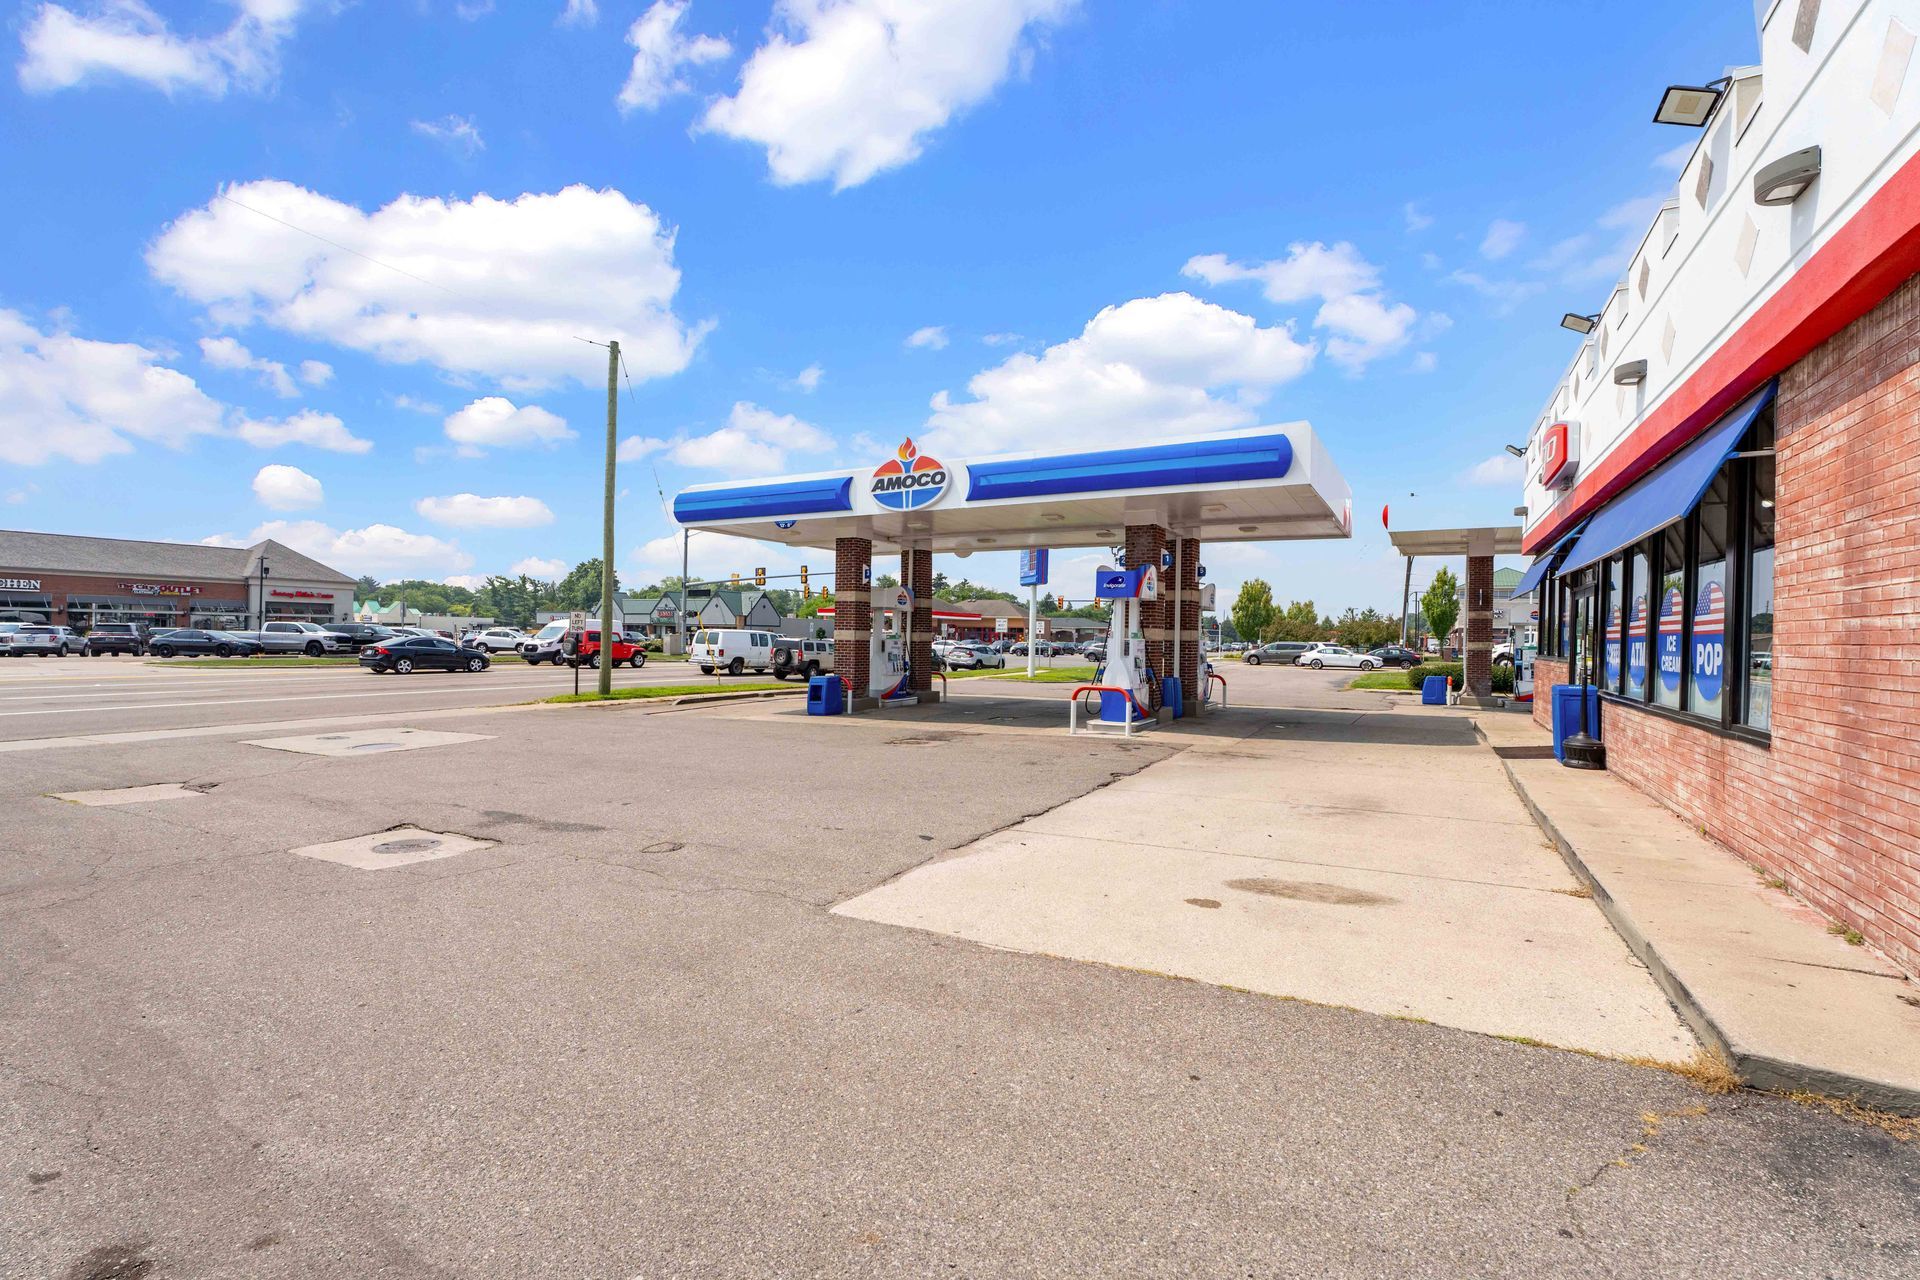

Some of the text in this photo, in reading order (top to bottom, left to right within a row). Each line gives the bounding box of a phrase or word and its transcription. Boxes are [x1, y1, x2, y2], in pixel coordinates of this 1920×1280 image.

[871, 471, 946, 492] AMOCO
[1630, 641, 1646, 667] ATM
[1666, 635, 1677, 652] ICE
[1696, 643, 1723, 675] POP
